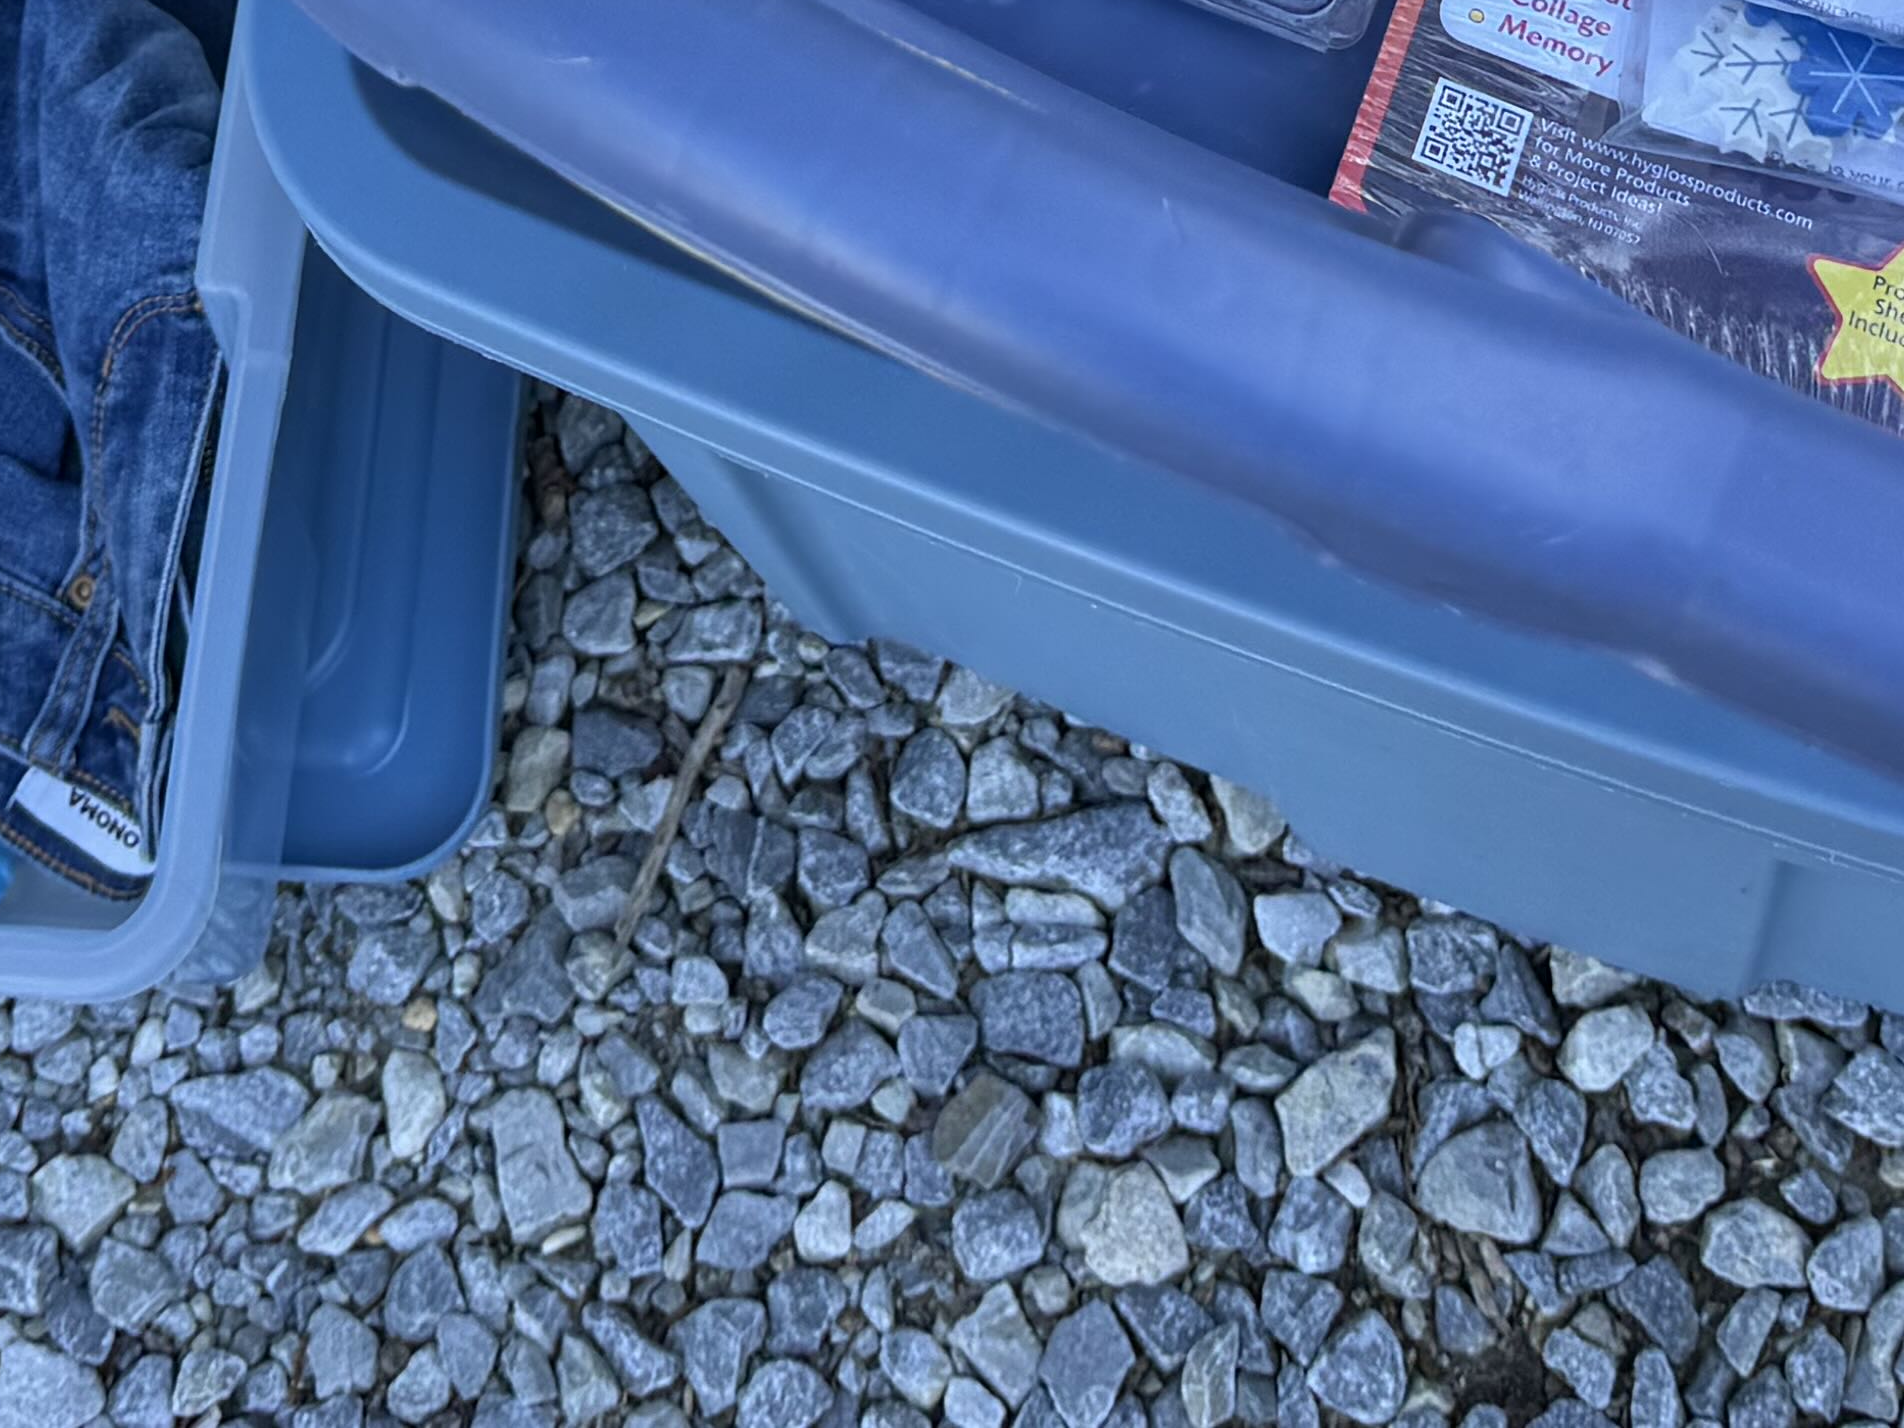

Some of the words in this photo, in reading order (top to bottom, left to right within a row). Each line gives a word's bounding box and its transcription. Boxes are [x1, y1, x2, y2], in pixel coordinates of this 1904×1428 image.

[1498, 13, 1615, 78] Memory
[1528, 154, 1542, 170] &
[1546, 160, 1607, 197] Project
[1610, 185, 1664, 216] Ideas!
[1534, 135, 1563, 155] for
[1564, 147, 1613, 177] More
[1615, 168, 1692, 208] Products
[1540, 117, 1578, 145] Visit
[1581, 136, 1814, 231] www.hyglossproducts.com
